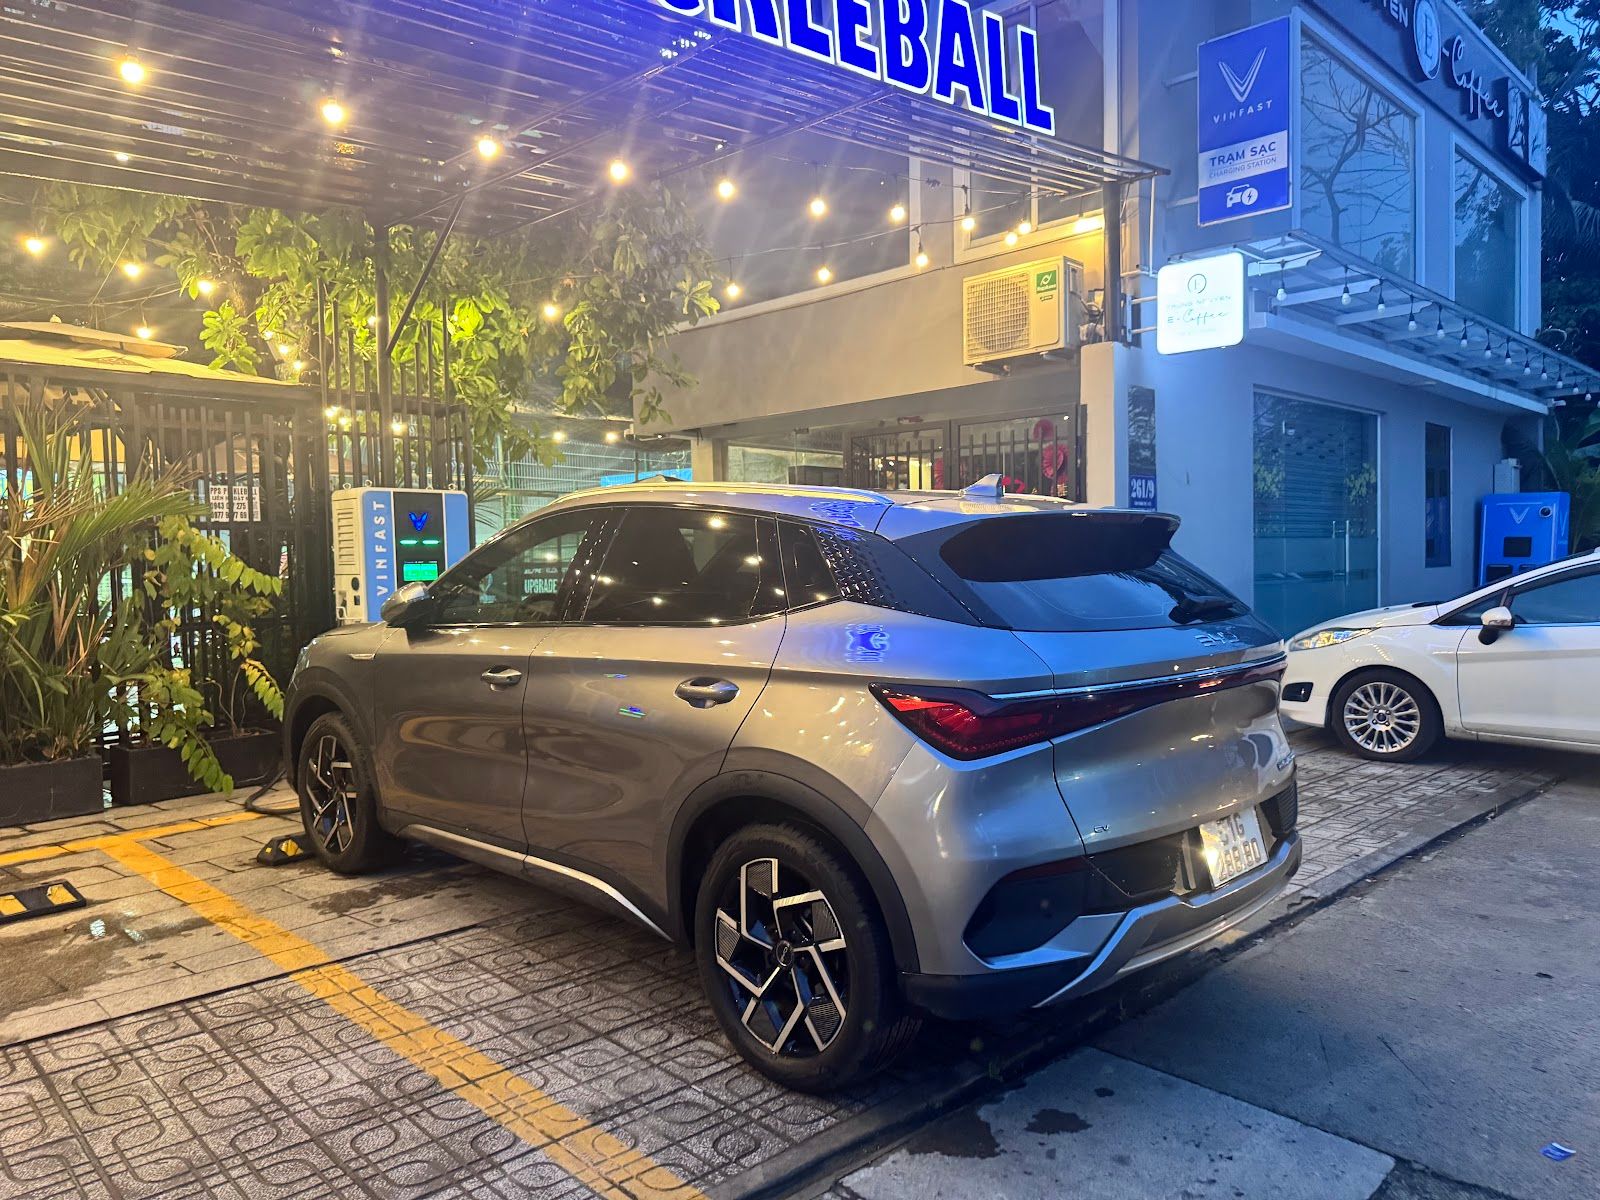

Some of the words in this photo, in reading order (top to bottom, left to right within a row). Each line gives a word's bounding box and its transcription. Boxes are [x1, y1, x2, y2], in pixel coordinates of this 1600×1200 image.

[1213, 99, 1273, 124] VINFAST
[1209, 149, 1246, 167] TRẠM
[1250, 141, 1277, 157] SẠC
[1247, 156, 1277, 170] STATION
[1130, 478, 1156, 499] 261/9
[373, 501, 389, 597] VINFAST
[524, 578, 558, 594] UPGRADE
